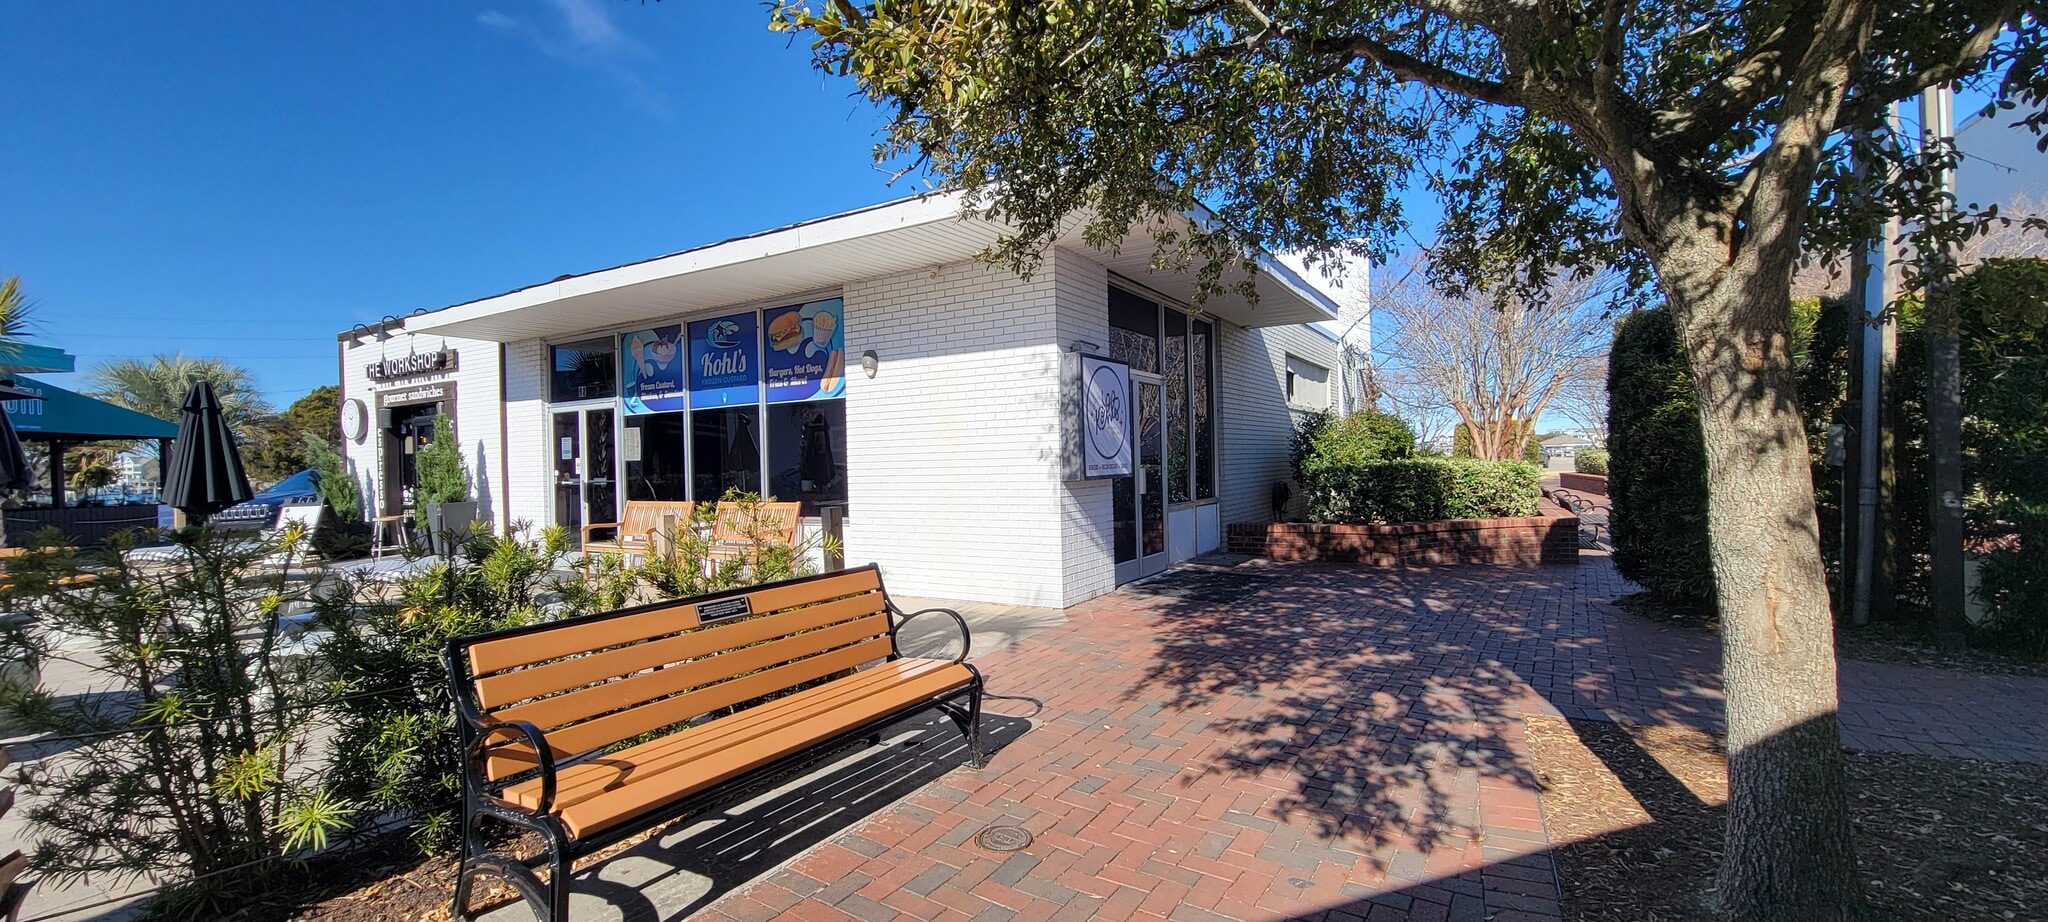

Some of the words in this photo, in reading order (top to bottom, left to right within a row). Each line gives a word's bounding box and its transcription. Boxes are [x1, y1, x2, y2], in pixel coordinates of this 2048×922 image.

[364, 362, 381, 378] THE
[383, 351, 437, 376] WORKSHOP
[701, 348, 747, 377] Kohl's
[793, 364, 805, 375] Hot
[701, 378, 722, 386] FROZEN
[722, 374, 748, 384] CUSTARD
[383, 392, 407, 406] gourmet
[408, 385, 444, 400] sandwiches
[377, 428, 385, 509] espresso
